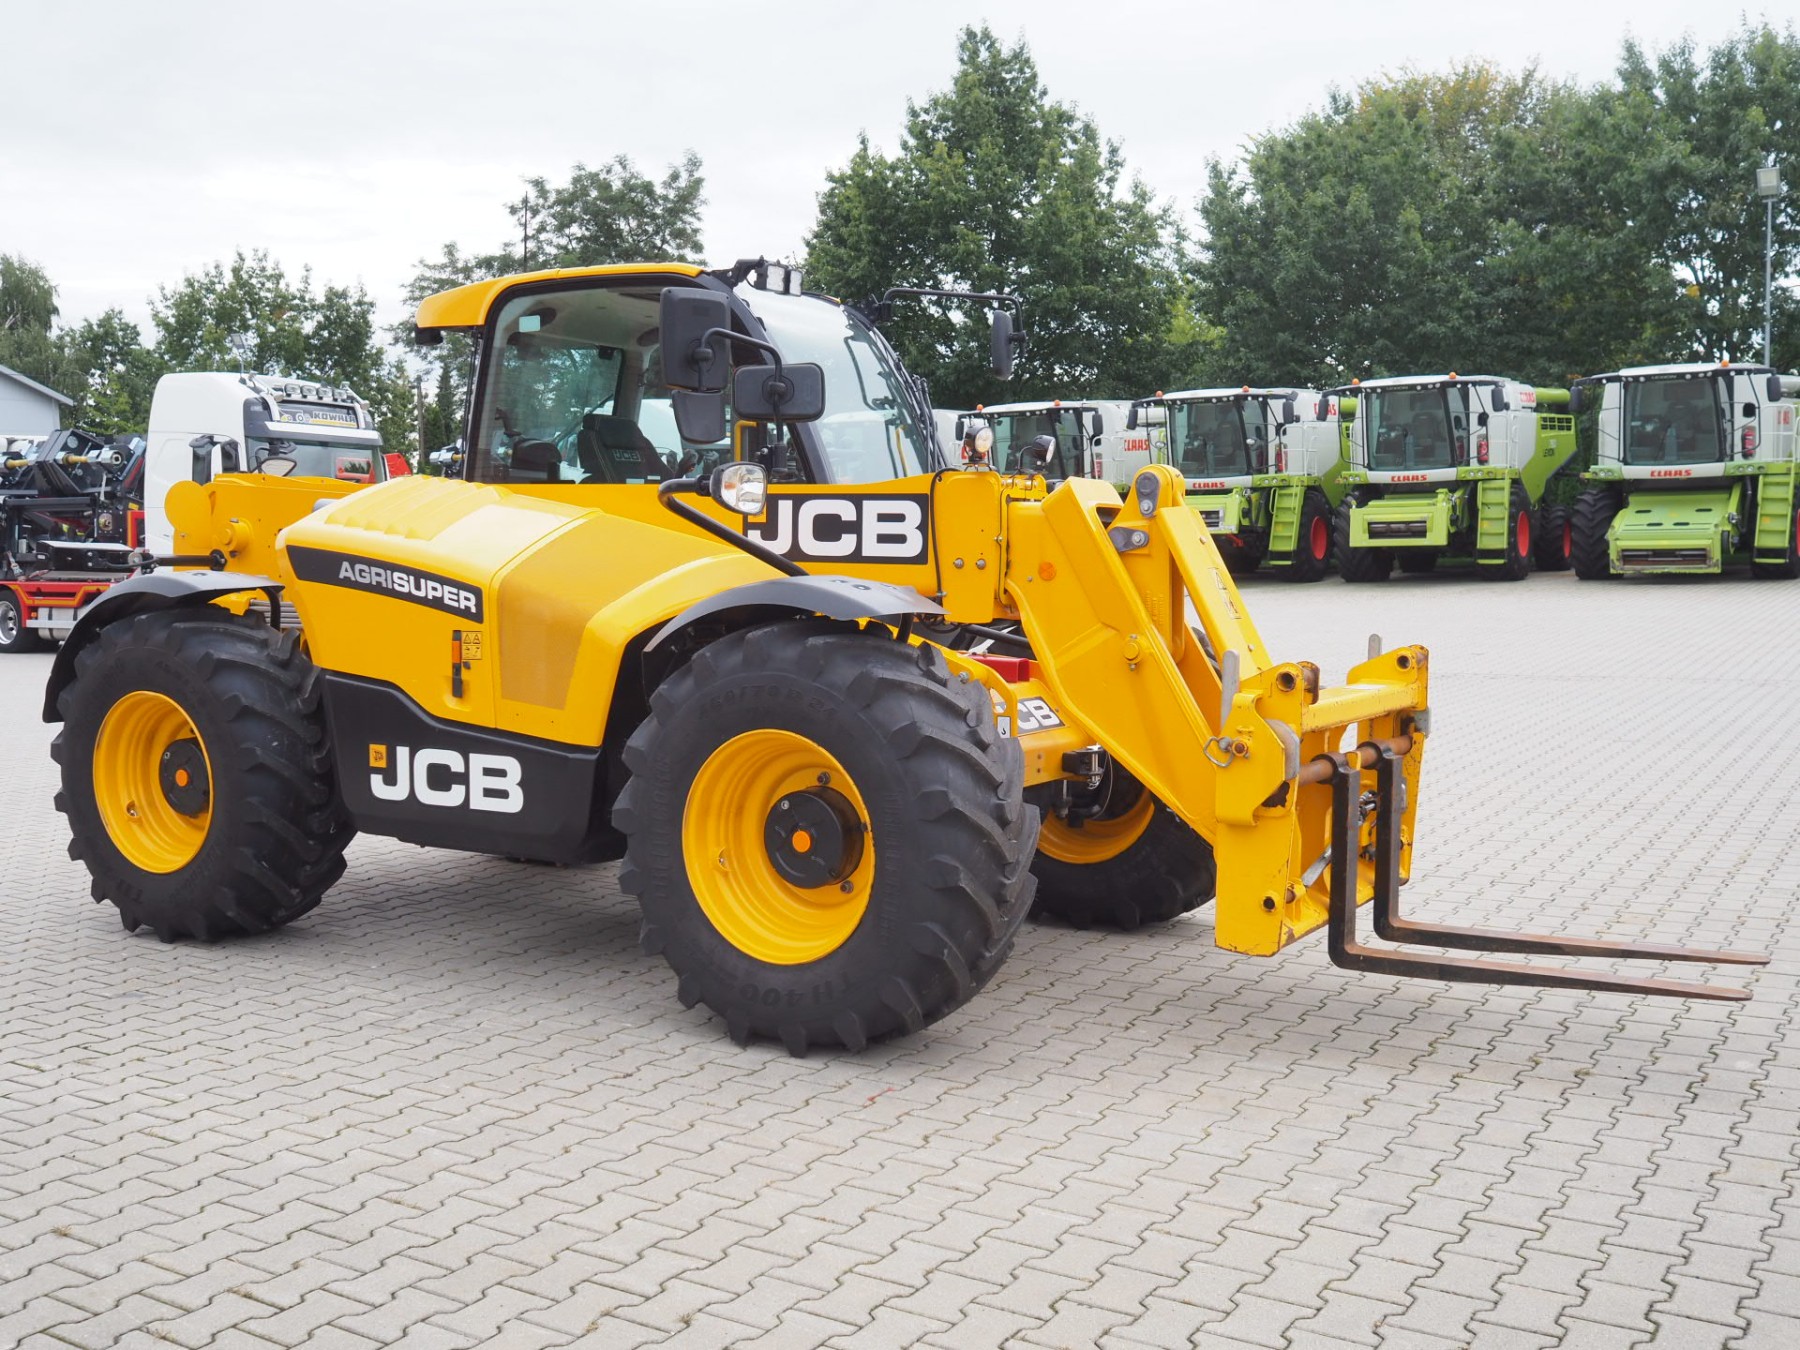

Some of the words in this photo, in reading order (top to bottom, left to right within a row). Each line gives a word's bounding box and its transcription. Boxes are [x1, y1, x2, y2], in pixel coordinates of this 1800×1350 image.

[1192, 481, 1226, 489] CLAAS
[1391, 474, 1428, 482] CLAAS
[1650, 469, 1692, 478] CLAAS
[747, 499, 924, 558] JCB
[338, 561, 477, 614] AGRISUPER
[996, 699, 1061, 730] CB
[370, 745, 525, 814] JCB
